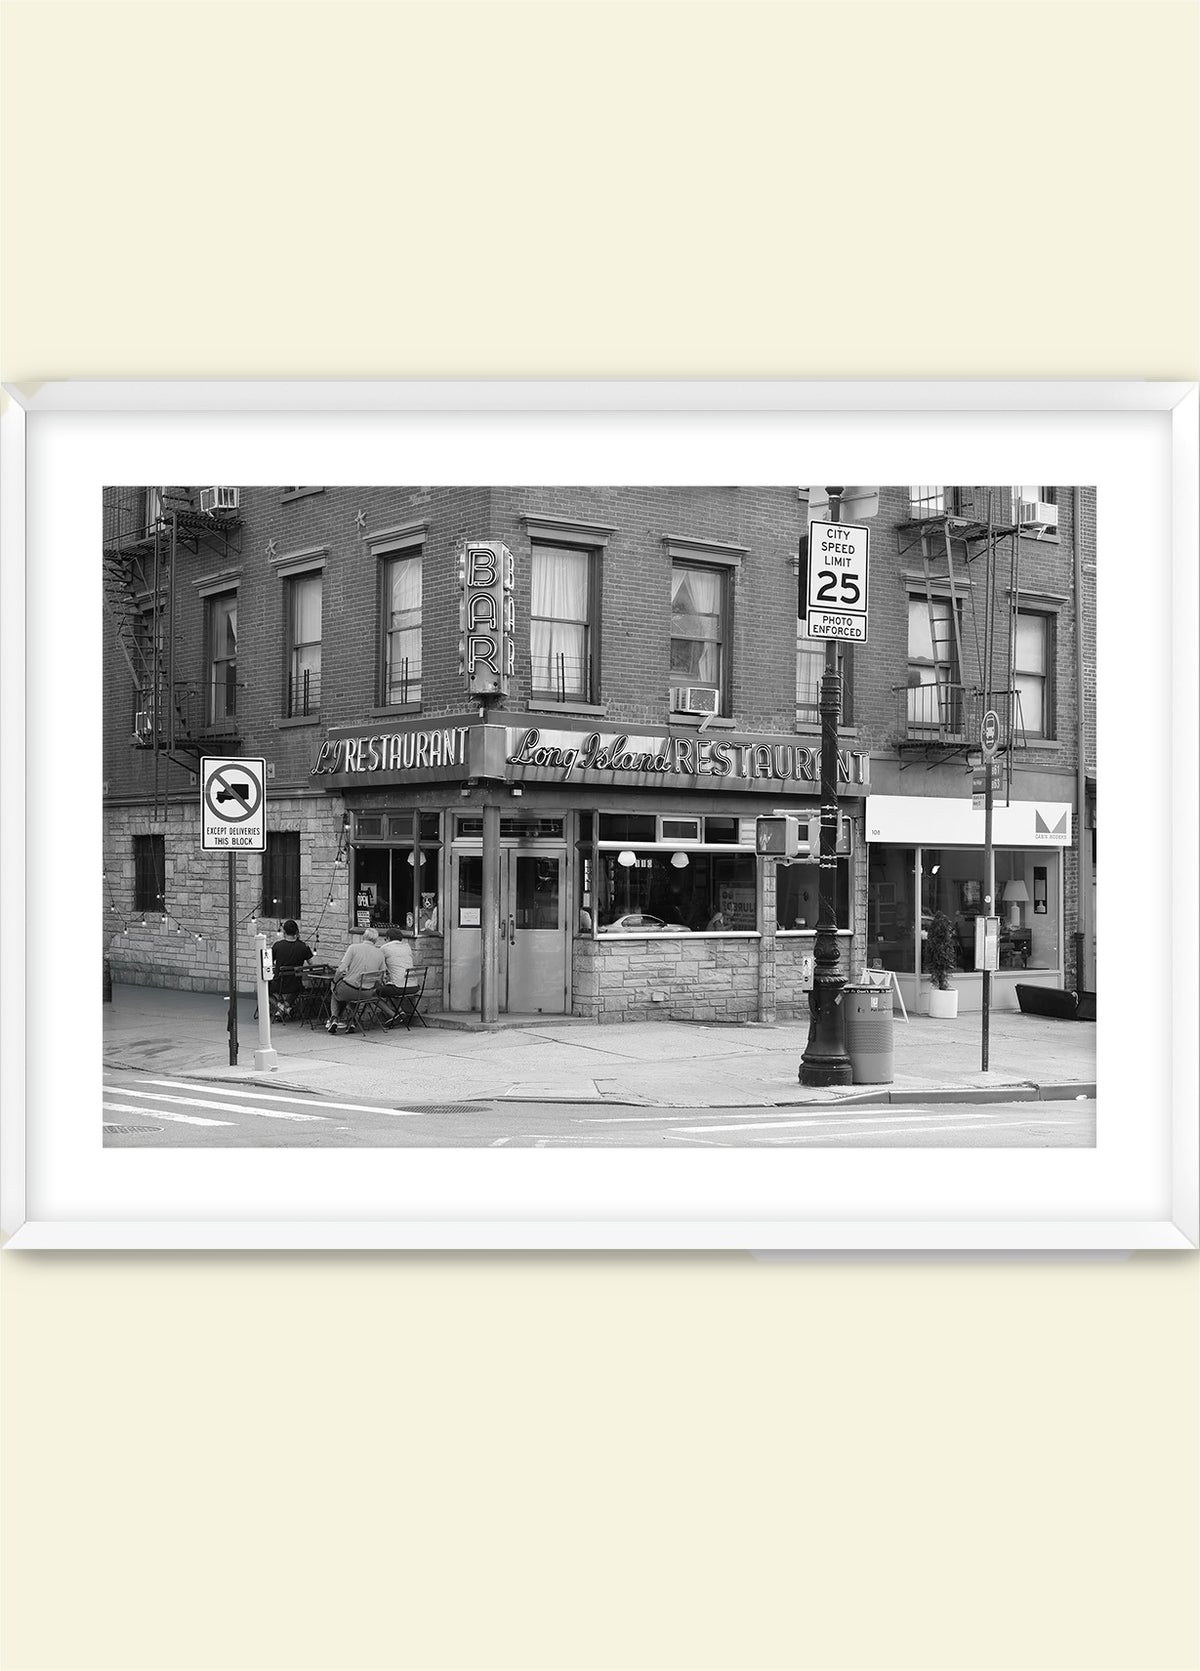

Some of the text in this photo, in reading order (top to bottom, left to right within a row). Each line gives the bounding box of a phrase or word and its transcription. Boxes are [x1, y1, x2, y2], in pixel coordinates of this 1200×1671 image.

[827, 528, 851, 541] CITY
[821, 541, 856, 555] SPEED
[824, 555, 852, 568] LIMIT
[816, 570, 861, 605] 25
[467, 548, 498, 674] BAR
[822, 615, 853, 627] PHOTO
[813, 624, 862, 638] ENFORCED
[344, 726, 469, 773] RESTAURANT
[511, 728, 580, 781] Long
[579, 732, 673, 772] Island
[206, 826, 261, 836] EXCEPT DELIVERIES
[214, 837, 253, 846] THIS BLOCK
